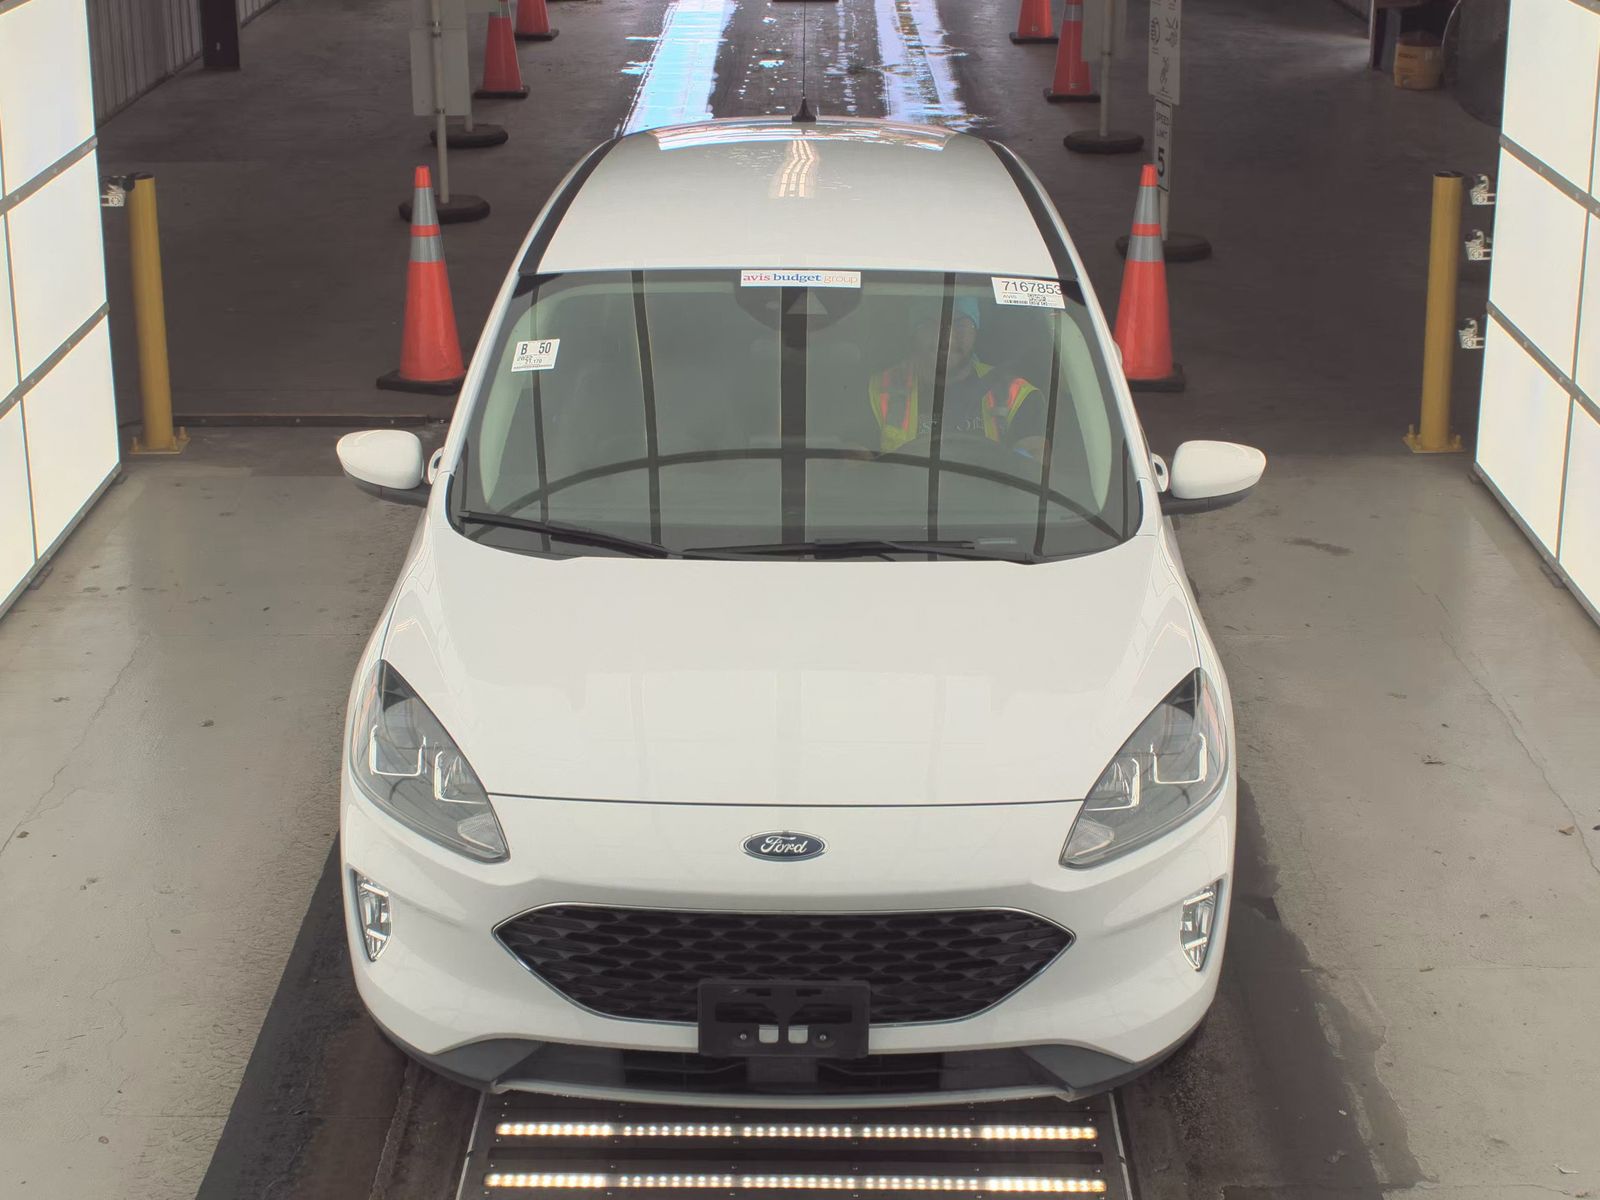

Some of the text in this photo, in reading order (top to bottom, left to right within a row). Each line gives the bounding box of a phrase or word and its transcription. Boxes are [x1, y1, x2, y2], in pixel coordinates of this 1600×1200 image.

[1157, 146, 1165, 178] 5
[743, 273, 858, 284] avis budget group
[1001, 280, 1062, 296] 7167853
[520, 341, 552, 355] B 50
[760, 835, 809, 854] Ford
